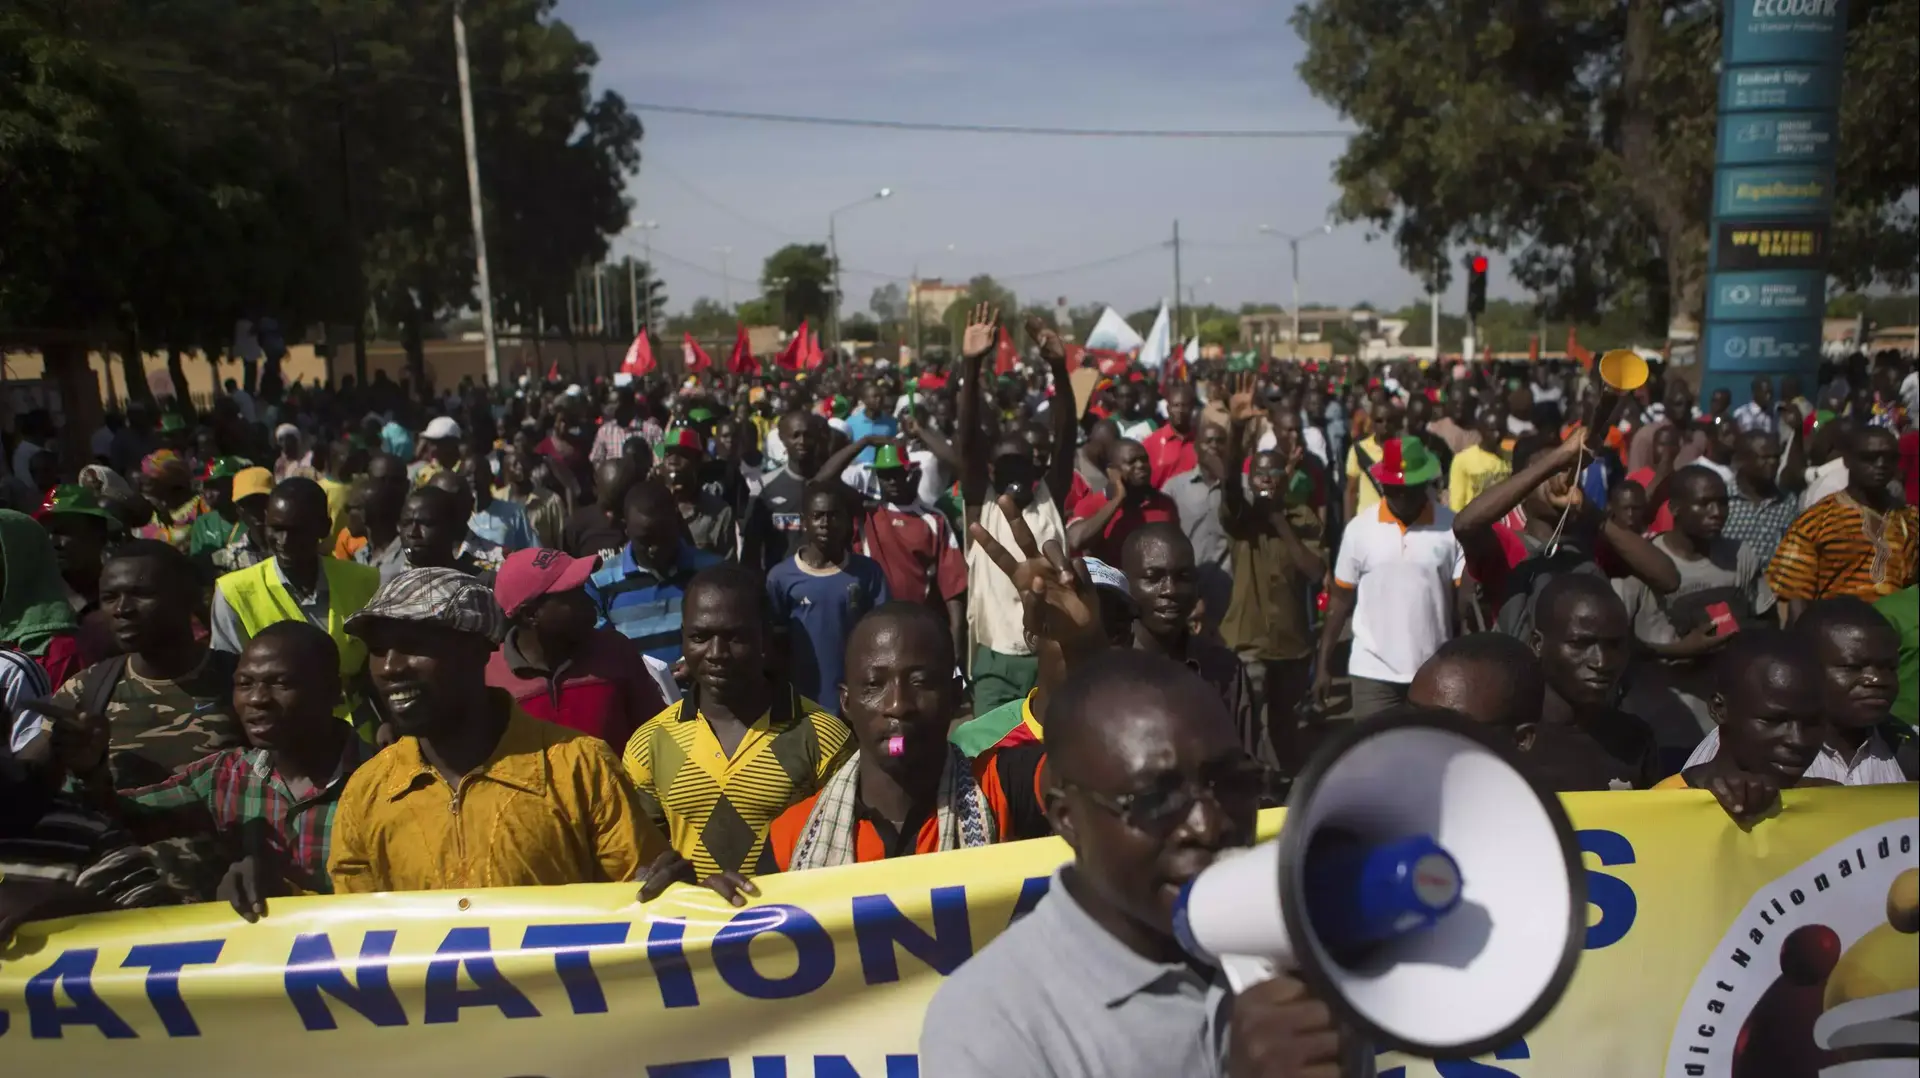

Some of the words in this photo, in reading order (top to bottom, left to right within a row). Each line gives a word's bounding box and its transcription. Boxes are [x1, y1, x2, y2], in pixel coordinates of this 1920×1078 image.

[1752, 0, 1838, 17] Ecobank
[1731, 229, 1815, 246] WESTERN
[1730, 848, 1867, 968] National
[0, 938, 227, 1040] AT
